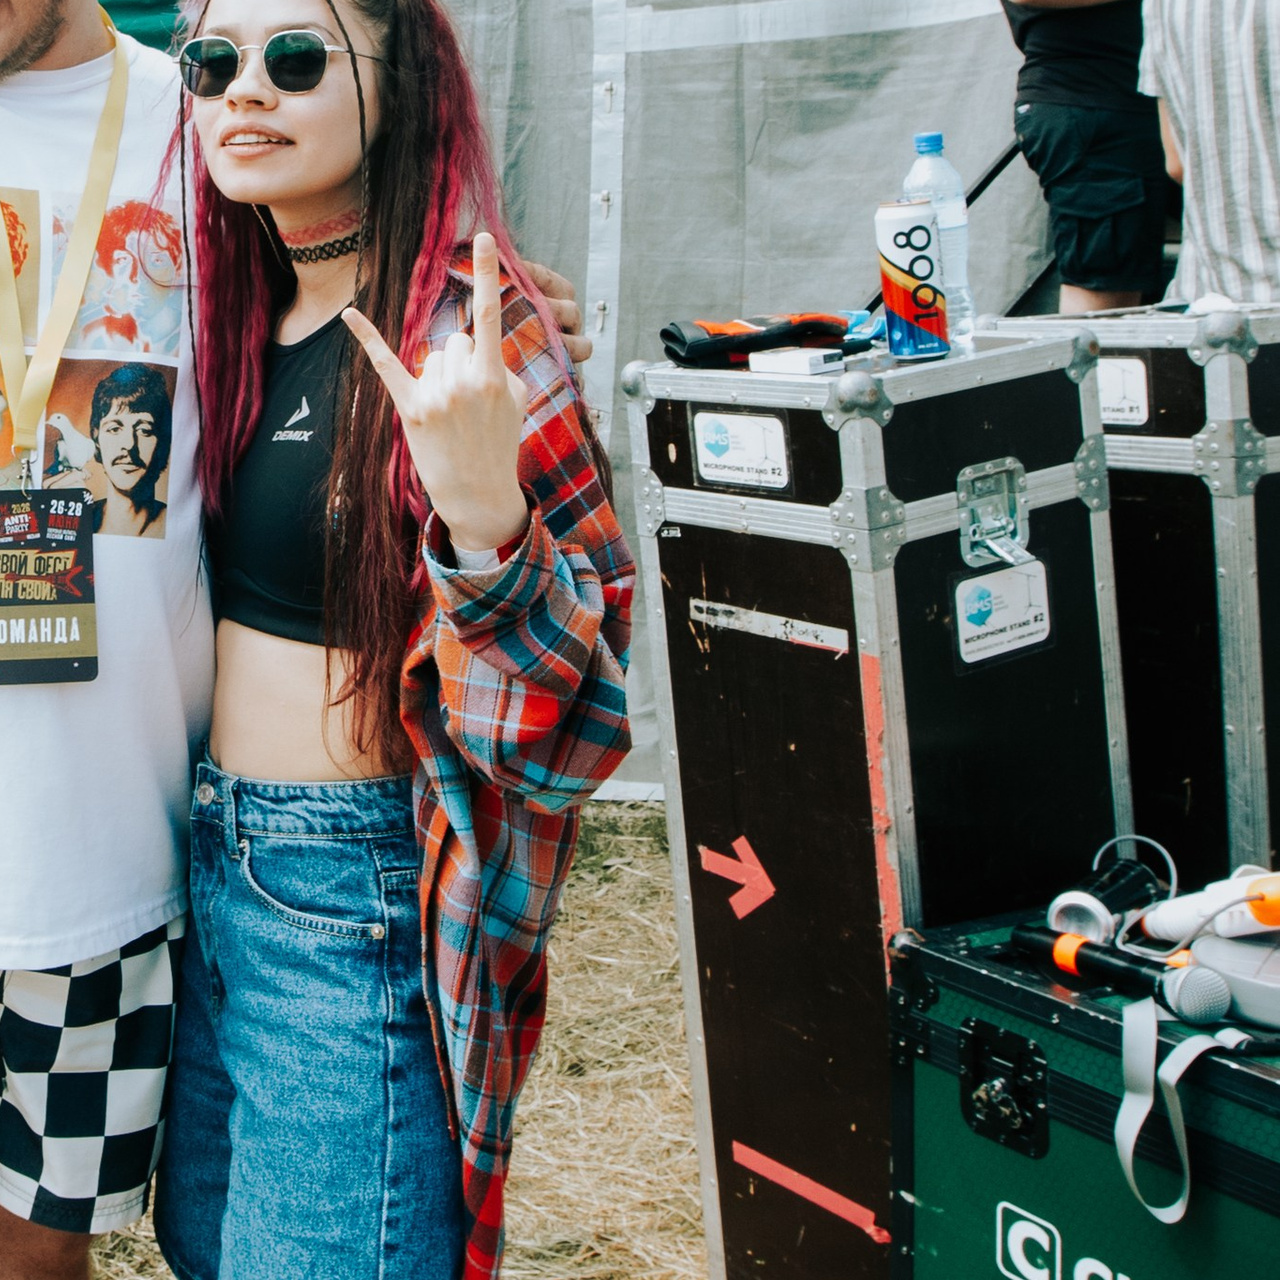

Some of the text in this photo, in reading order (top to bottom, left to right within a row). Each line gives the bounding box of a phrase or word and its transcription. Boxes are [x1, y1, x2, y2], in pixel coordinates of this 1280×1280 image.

[893, 225, 939, 324] 1968
[271, 430, 314, 441] DEMIX
[703, 462, 744, 473] MICROPHONE
[746, 467, 768, 475] STAND
[5, 523, 29, 534] PARTY
[34, 555, 70, 576] ФЕСТ
[964, 626, 1007, 644] MICROPHONE
[1009, 619, 1031, 631] STAND
